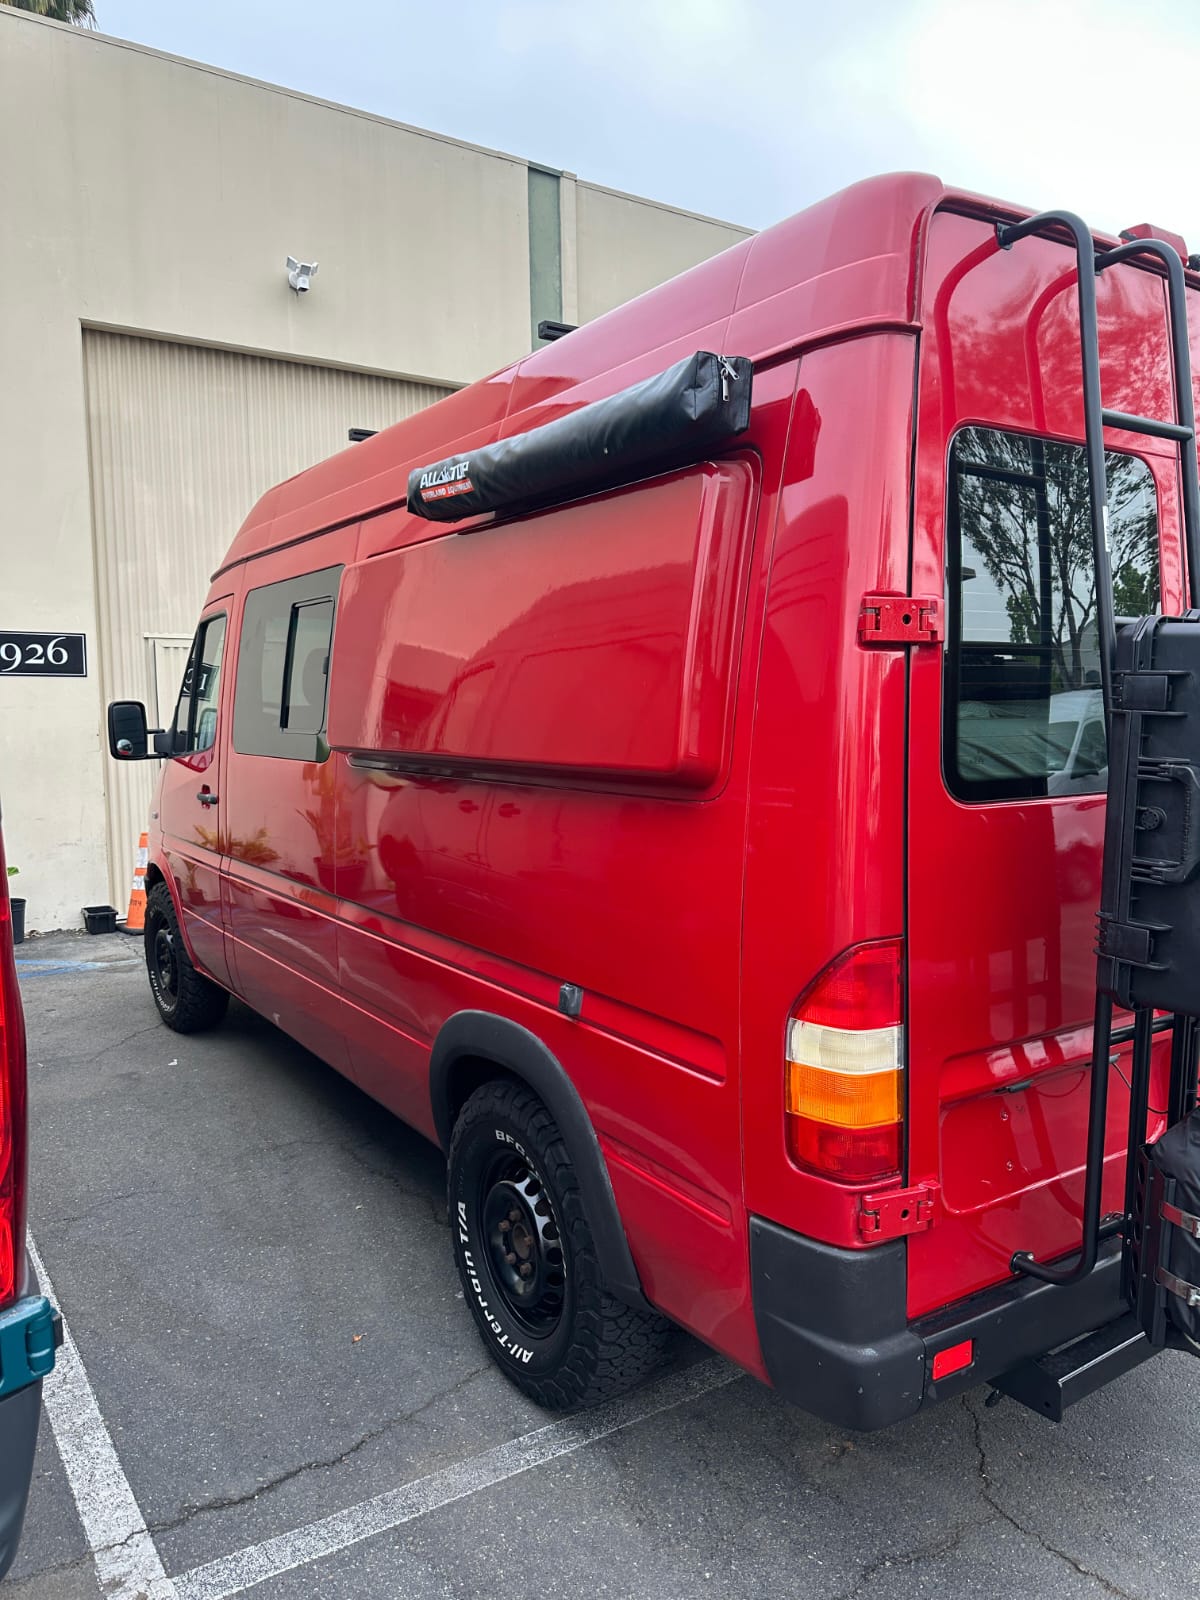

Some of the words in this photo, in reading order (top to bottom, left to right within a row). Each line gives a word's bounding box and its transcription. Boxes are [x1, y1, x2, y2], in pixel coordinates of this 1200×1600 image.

[0, 636, 68, 671] 926
[457, 1201, 469, 1244] T/A
[464, 1250, 534, 1363] All-Terrain
